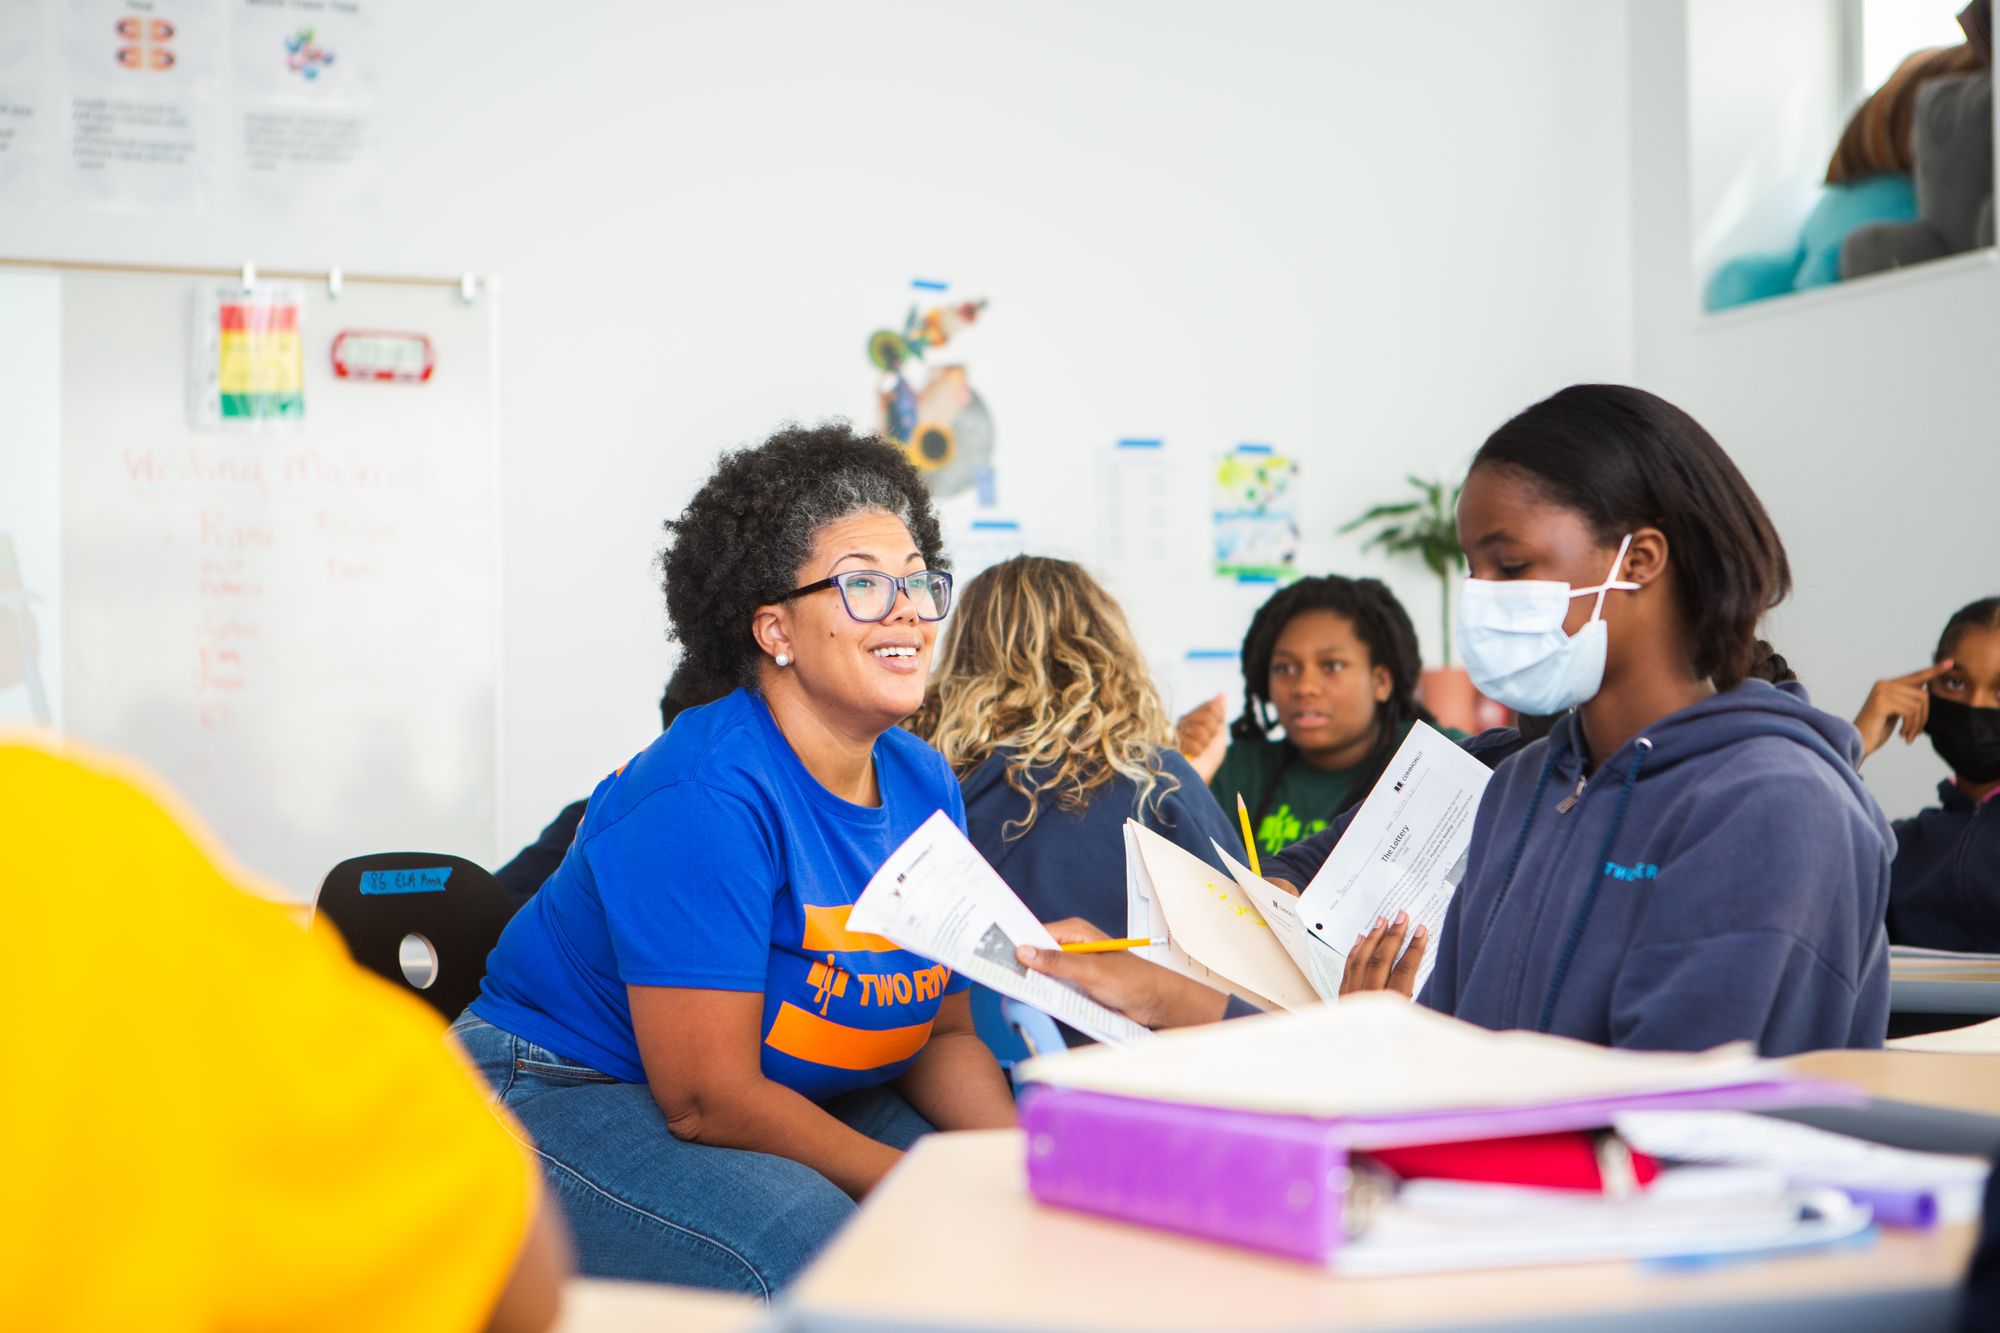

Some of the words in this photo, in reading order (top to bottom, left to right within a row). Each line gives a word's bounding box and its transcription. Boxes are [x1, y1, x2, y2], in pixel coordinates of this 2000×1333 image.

[1380, 848, 1393, 863] The
[1388, 823, 1410, 851] Lottery
[857, 973, 913, 1007] TWO
